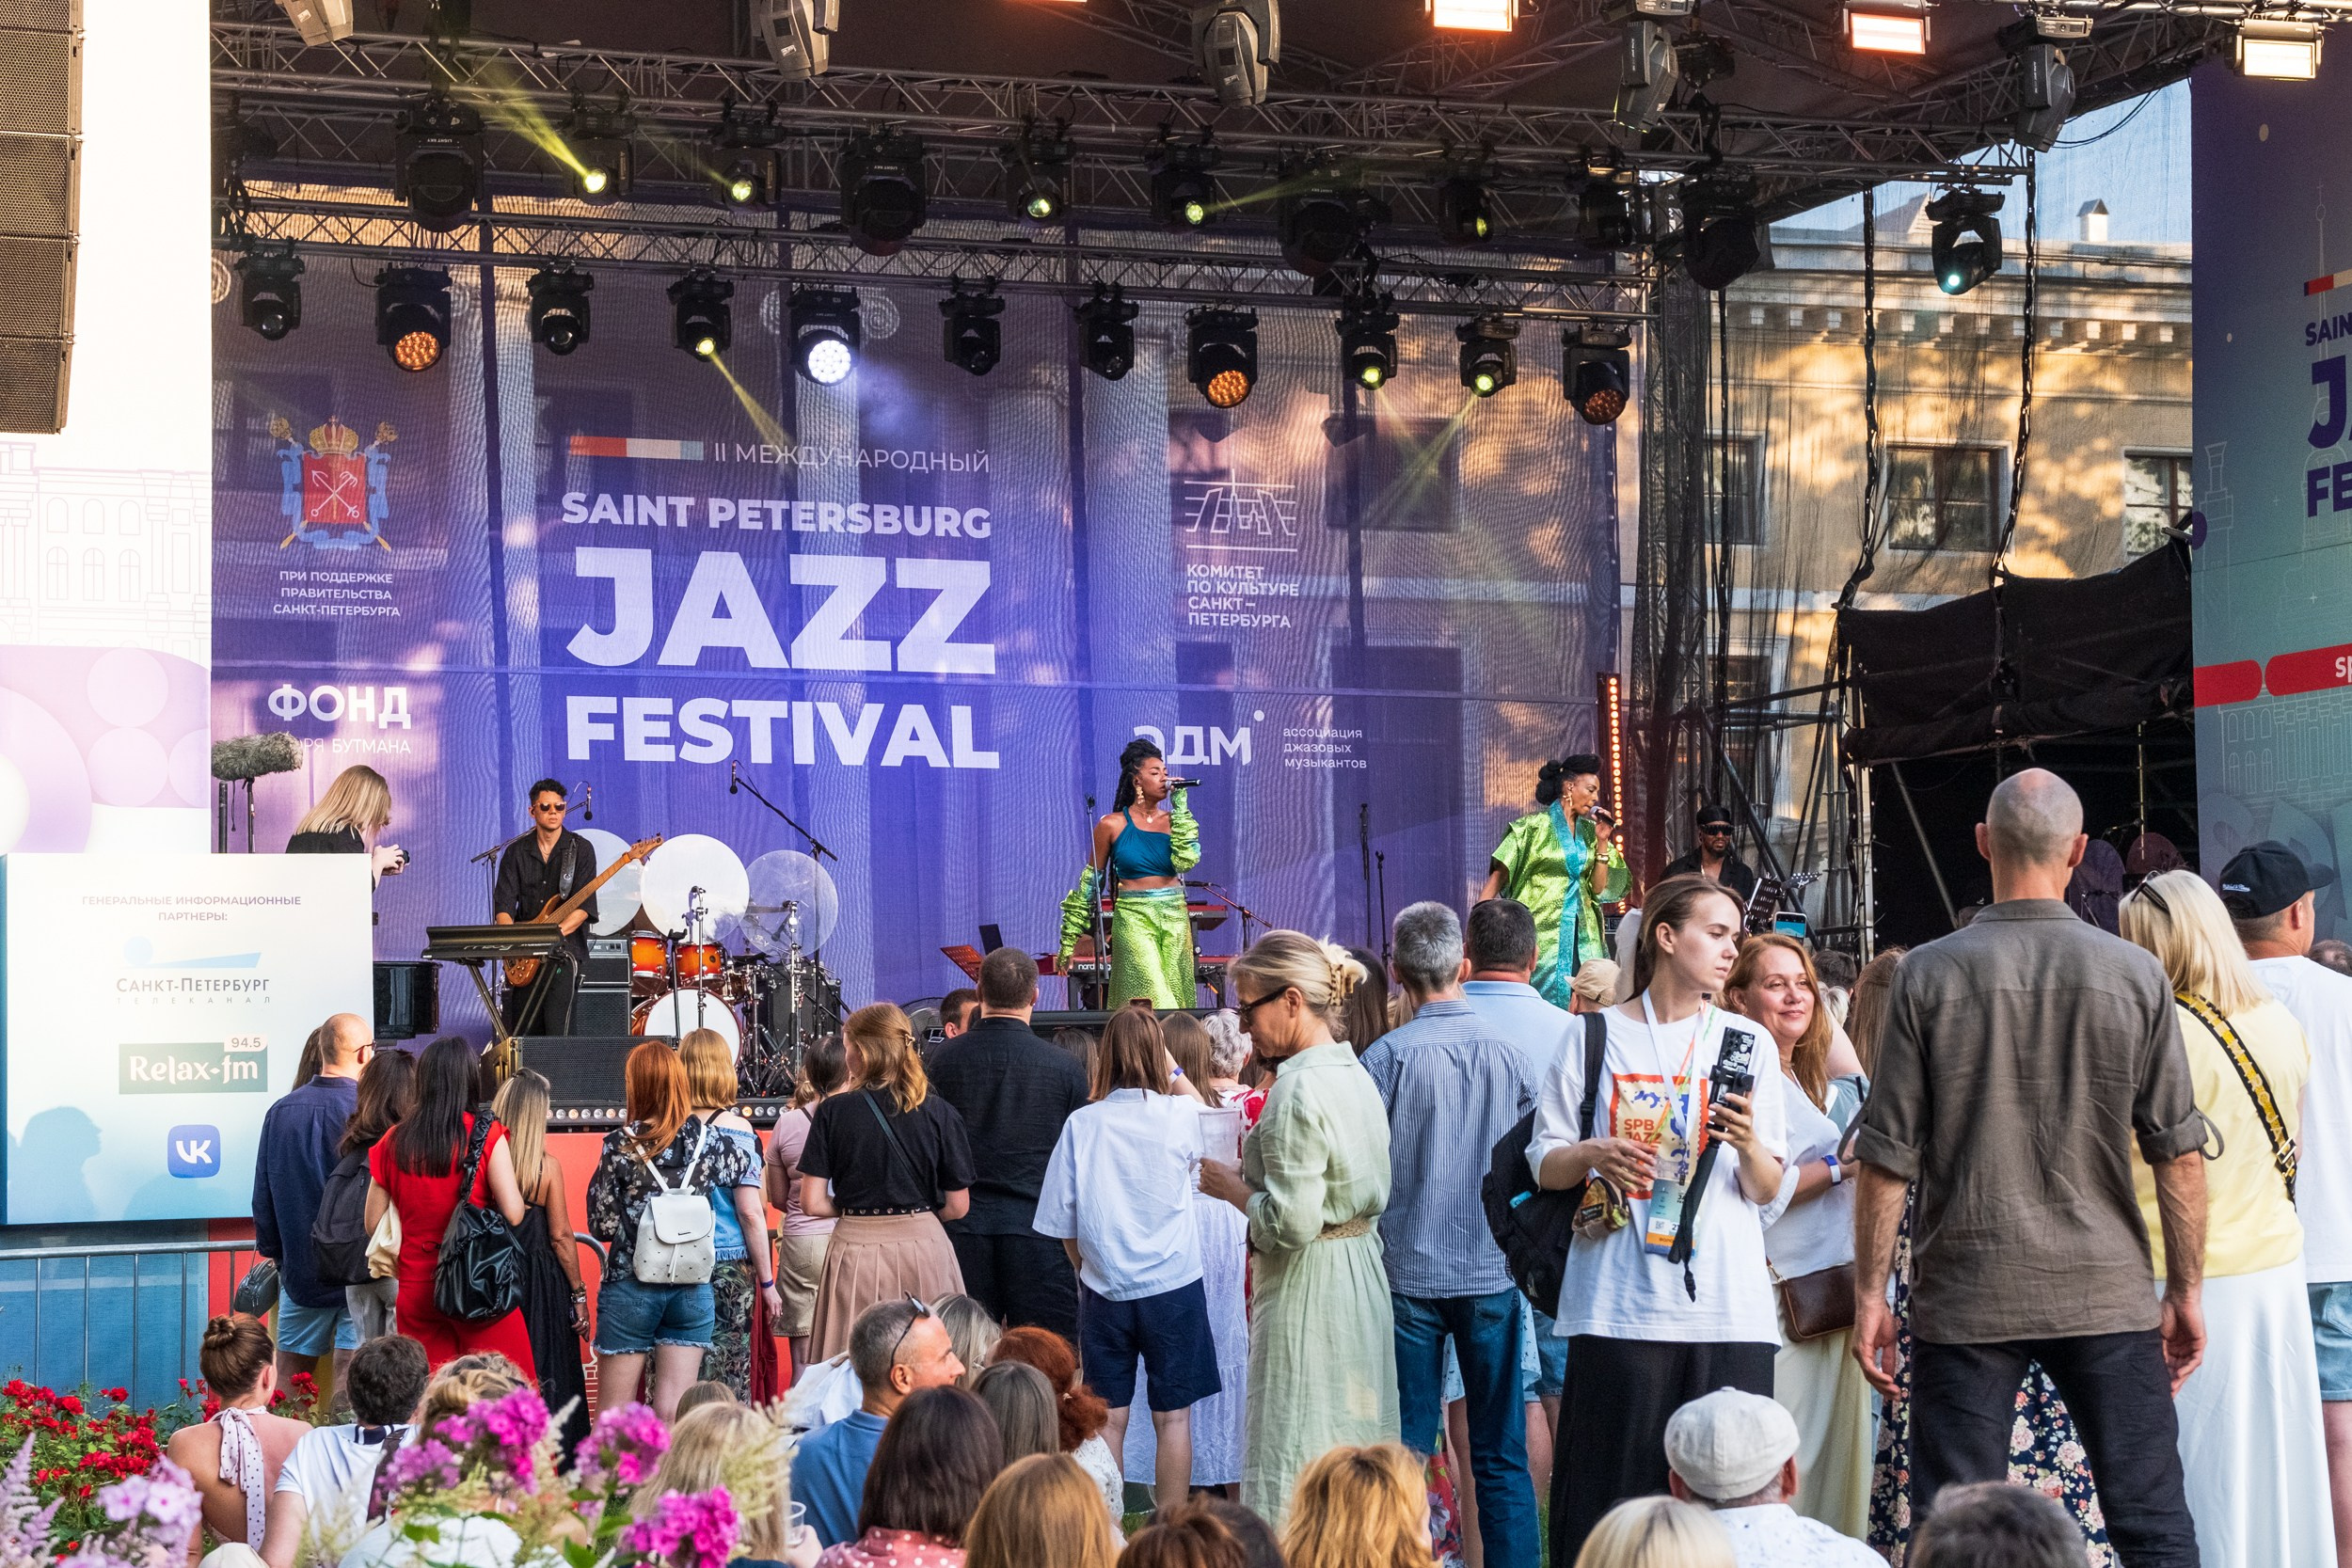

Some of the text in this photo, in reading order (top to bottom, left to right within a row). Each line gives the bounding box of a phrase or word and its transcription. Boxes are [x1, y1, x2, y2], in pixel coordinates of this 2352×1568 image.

[2308, 355, 2352, 450] J
[736, 444, 990, 473] МЕЖДУНАРОДНЫЙ
[562, 492, 992, 538] SAINT PETERSBURG
[279, 571, 393, 584] ПРИ ПОДДЕРЖКЕ
[1187, 564, 1263, 579] КОМИТЕТ
[281, 588, 392, 600] ПРАВИТЕЛЬСТВА
[1187, 580, 1299, 596] ПО КУЛЬТУРЕ
[273, 604, 401, 617] САНКТ-ПЕТЕРБУРГА
[566, 546, 995, 675] JAZZ
[1188, 612, 1291, 628] ПЕТЕРБУРГА
[267, 684, 412, 730] ФОНД
[566, 696, 1000, 769] FESTIVAL
[1283, 727, 1363, 739] ассоциация
[332, 738, 411, 753] БУТМАНА
[1283, 742, 1352, 754] джазовых
[1284, 757, 1367, 769] музыкантов
[82, 895, 301, 907] ГЕНЕРАЛЬНЫЕ ИНФОРМАЦИОННЫЕ
[158, 911, 228, 922] ПАРТНЕРЫ:
[230, 1037, 262, 1049] 94.5
[1624, 1118, 1655, 1131] SPB
